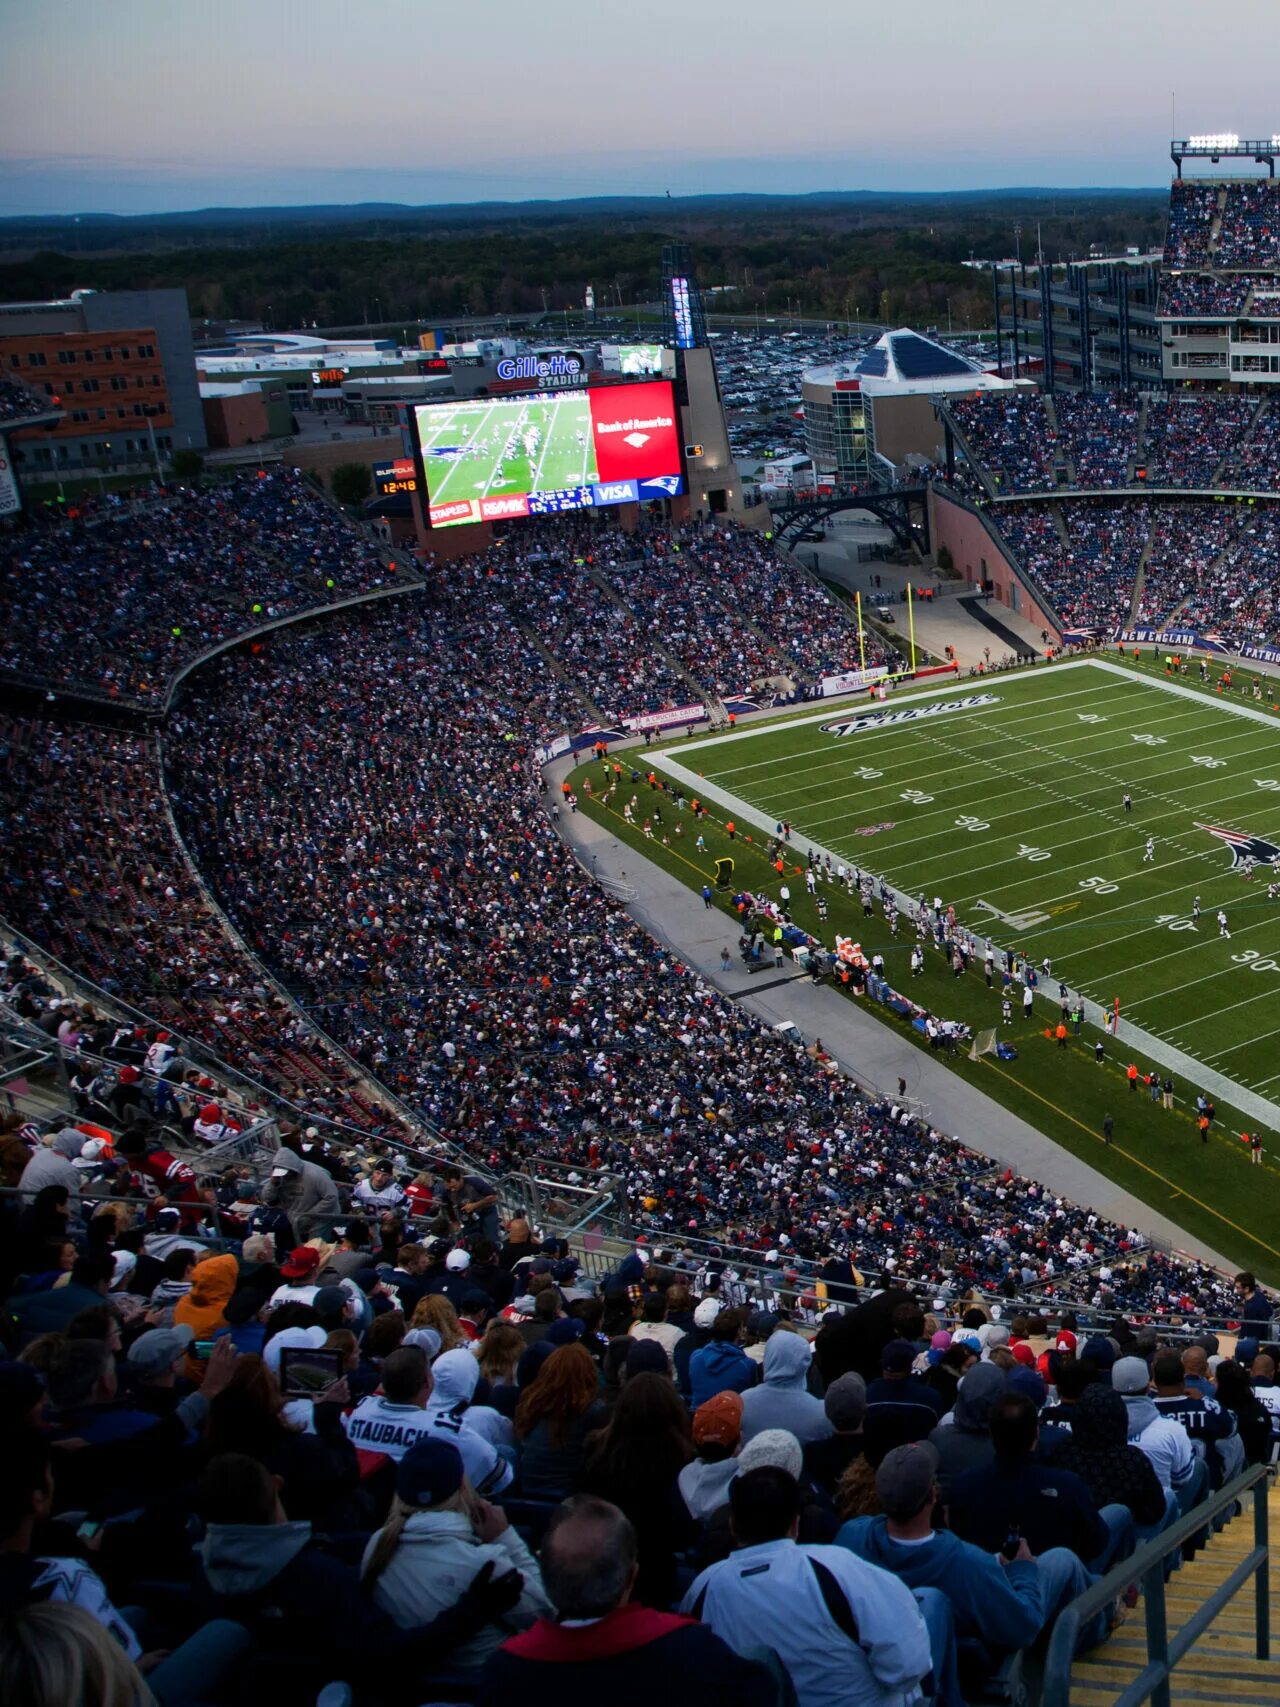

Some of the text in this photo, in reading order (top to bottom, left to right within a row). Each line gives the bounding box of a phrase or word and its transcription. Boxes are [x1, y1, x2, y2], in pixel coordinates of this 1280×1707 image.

[447, 358, 478, 366] SCENE
[497, 355, 581, 380] Gillette
[538, 373, 589, 388] STADIUM
[597, 416, 672, 433] Bank of America
[694, 446, 702, 456] 5
[376, 467, 415, 476] SUFFOLK
[383, 481, 416, 493] 12:48
[596, 485, 633, 500] VISA
[430, 503, 470, 521] STAPLES
[482, 498, 527, 516] RE/MAX
[530, 502, 543, 513] 13
[581, 495, 593, 507] 10
[1121, 631, 1194, 645] NEW ENGLAND
[820, 694, 1004, 738] Patriots
[899, 790, 935, 805] 20
[955, 815, 991, 832] 30
[1016, 845, 1052, 862] 40
[1078, 876, 1120, 894] 50
[1154, 914, 1195, 931] 40
[1231, 950, 1277, 973] 30
[349, 1417, 429, 1447] STAUBACH
